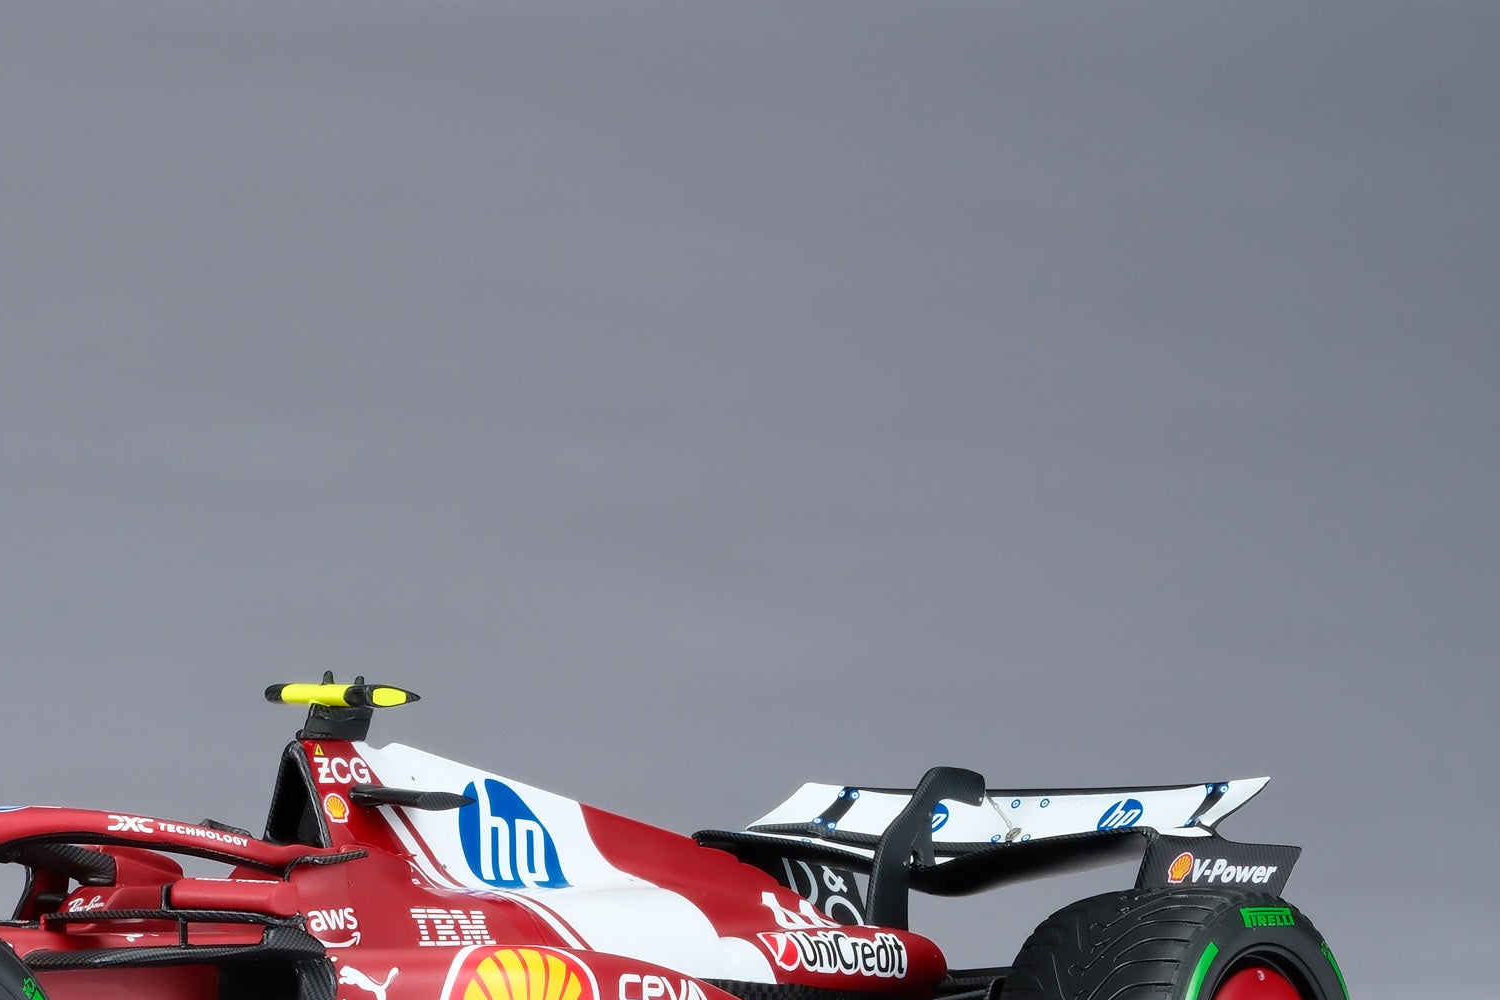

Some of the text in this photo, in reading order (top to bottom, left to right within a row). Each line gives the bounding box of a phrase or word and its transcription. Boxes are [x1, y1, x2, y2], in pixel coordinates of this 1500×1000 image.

[1100, 799, 1142, 830] hp
[107, 815, 248, 847] DXC TECHNOLOGY
[473, 779, 550, 889] hp
[1192, 858, 1277, 884] V-Power
[307, 907, 358, 932] aws
[410, 908, 497, 947] IBM
[1239, 907, 1295, 928] PIRELLI
[790, 932, 905, 975] UniCredit
